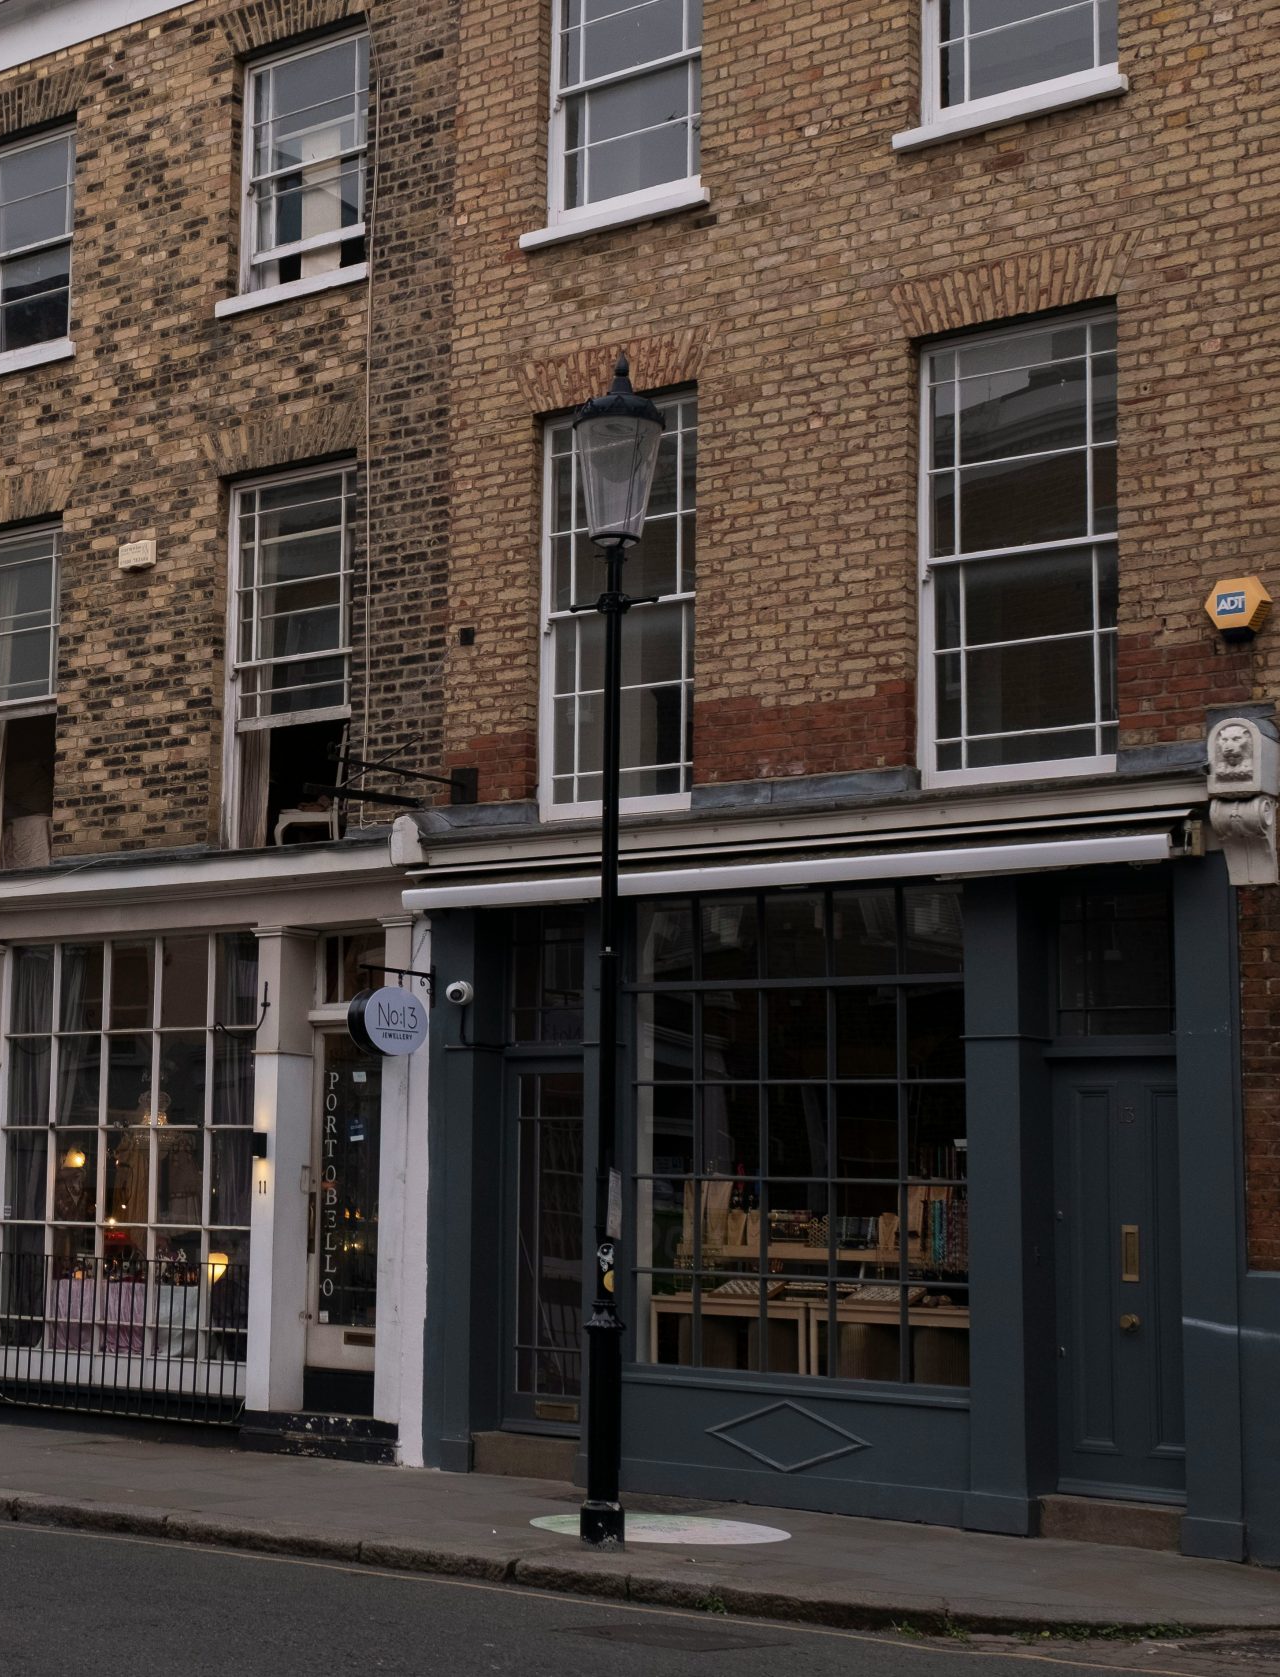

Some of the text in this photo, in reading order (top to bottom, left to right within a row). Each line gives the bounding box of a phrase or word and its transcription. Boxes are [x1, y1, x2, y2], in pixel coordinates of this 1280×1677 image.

[1217, 595, 1246, 611] ADT
[382, 1031, 413, 1041] JEWELLERY
[258, 1180, 267, 1195] 11
[322, 1071, 340, 1297] PORTOBELLO
